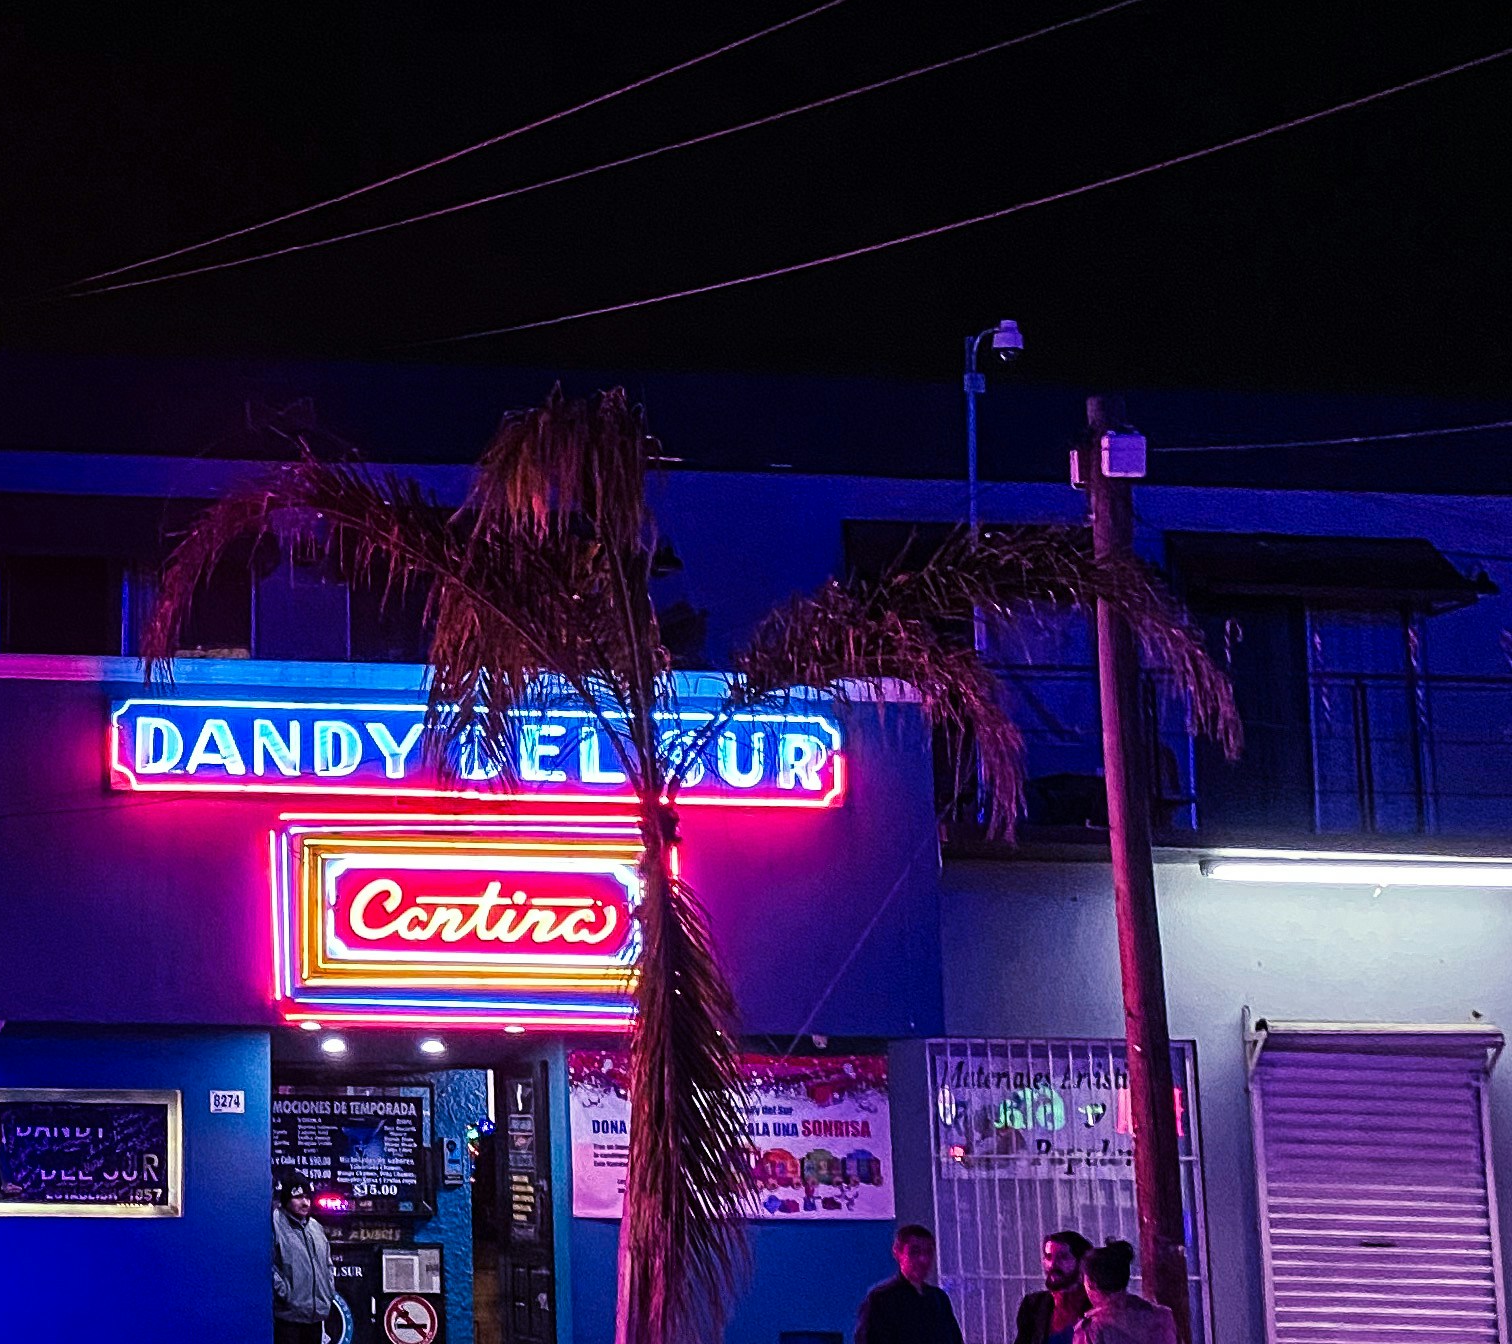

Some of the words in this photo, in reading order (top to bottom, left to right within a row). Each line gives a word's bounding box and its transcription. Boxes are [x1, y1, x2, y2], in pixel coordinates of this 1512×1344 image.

[135, 716, 424, 779] DANDY
[349, 878, 617, 944] Cantina
[214, 1094, 241, 1107] 8274
[334, 1101, 348, 1115] DE
[349, 1101, 417, 1116] TEMPORADA
[592, 1120, 627, 1134] DONA
[773, 1122, 799, 1137] UNA
[801, 1120, 872, 1138] SONRISA
[340, 1266, 363, 1277] SUR
